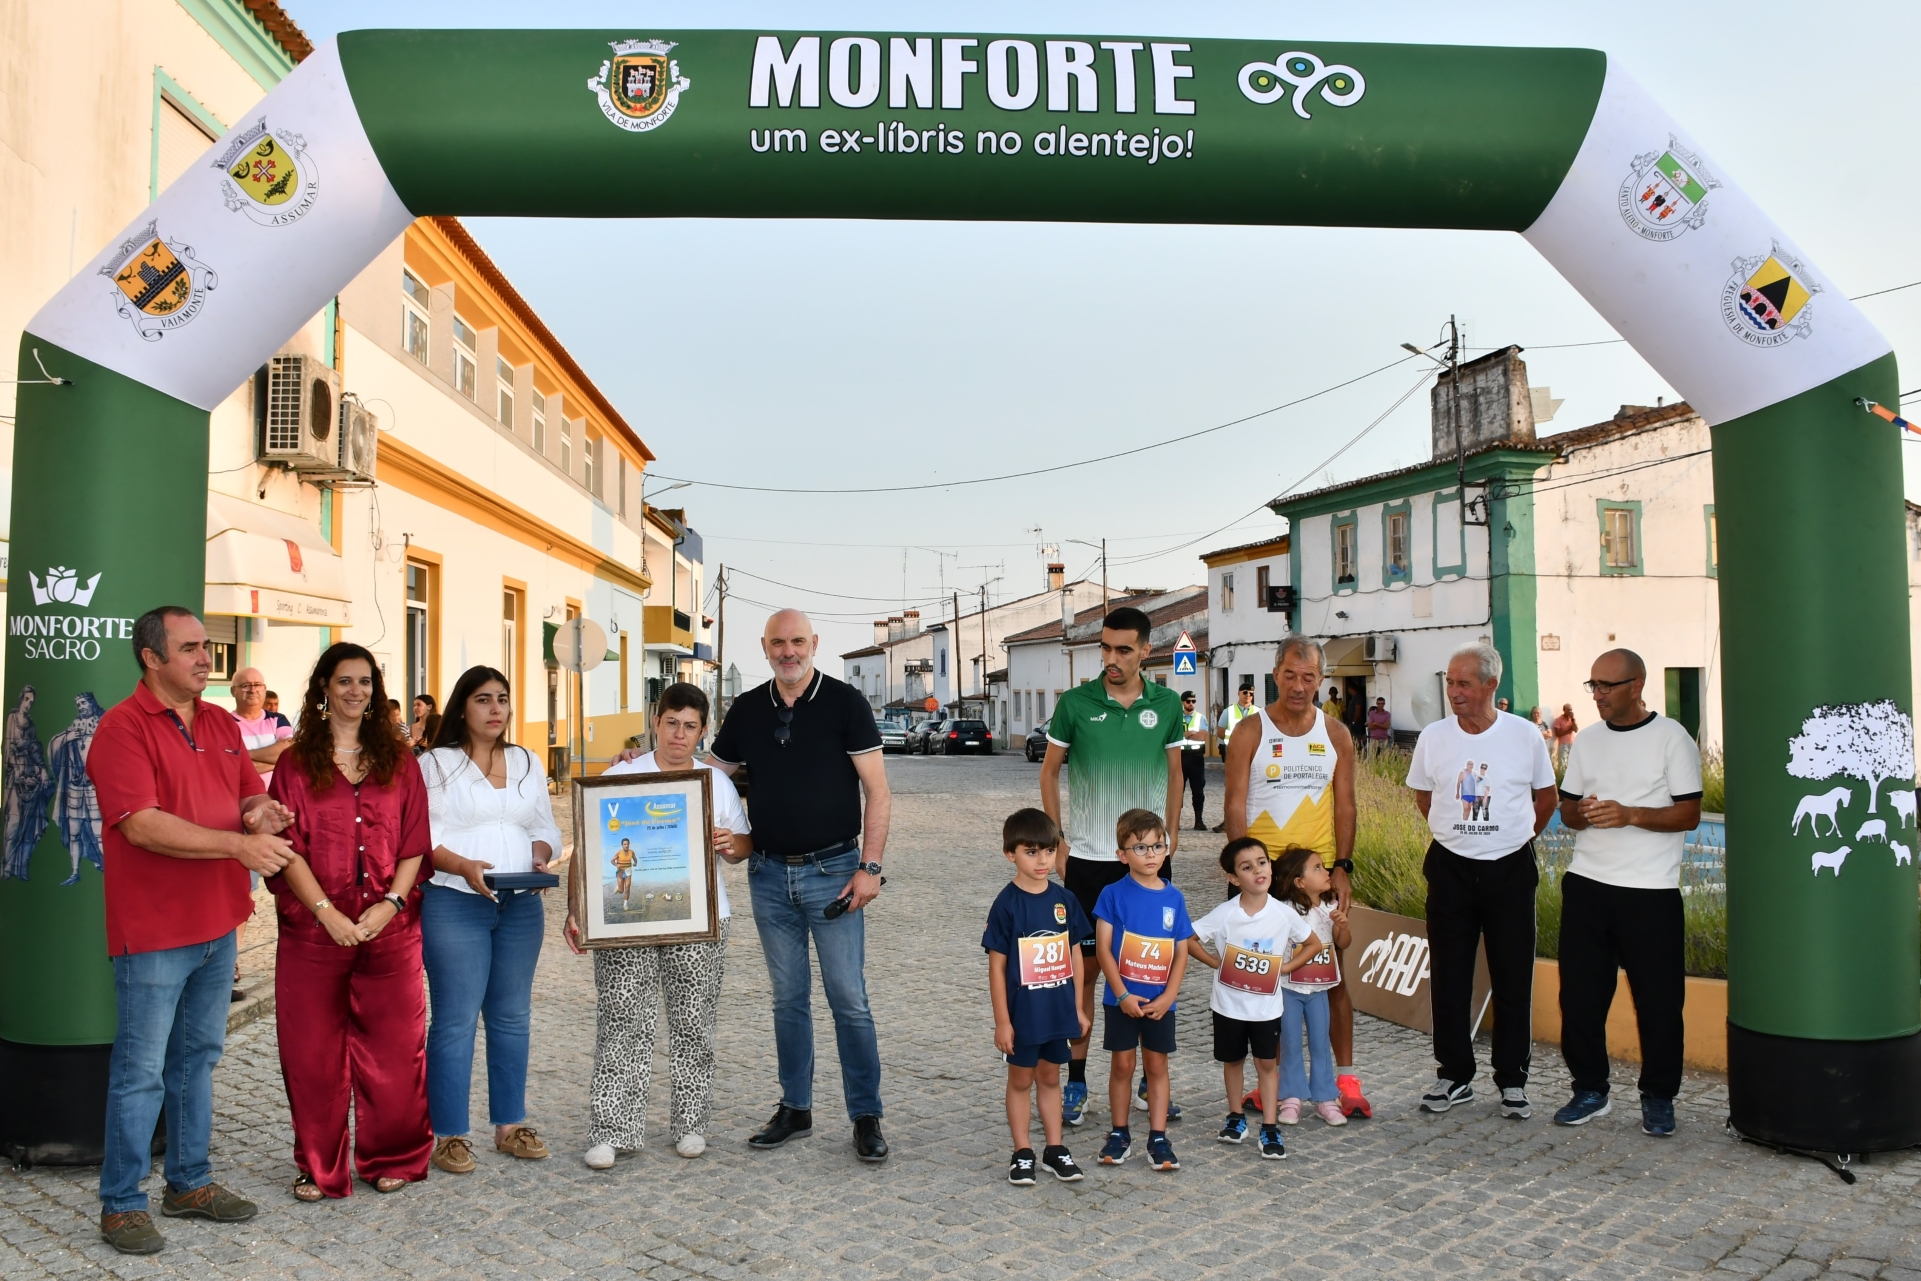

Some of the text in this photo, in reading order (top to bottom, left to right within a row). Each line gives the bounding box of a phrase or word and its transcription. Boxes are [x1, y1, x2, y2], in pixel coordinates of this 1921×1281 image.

[748, 36, 1196, 116] MONFORTE
[602, 101, 676, 130] VILA DE MONFORTE
[750, 120, 1194, 165] um ex-líbris no alentejo!
[271, 182, 317, 225] ASSUMAR
[1620, 185, 1675, 240] SANTO ALEIXO MONFORTE
[161, 288, 204, 328] VAIAMONTE
[1723, 280, 1789, 346] FREGUESIA DE MONFORTE
[10, 615, 135, 639] MONFORTE
[25, 638, 101, 661] SACRO
[1283, 764, 1323, 772] POLITÉCNICO
[1293, 772, 1329, 781] PORTALEGRE
[653, 802, 676, 810] Assumar
[1452, 823, 1466, 831] JOSÉ
[1032, 939, 1065, 965] 287
[1140, 941, 1160, 960] 74
[1033, 965, 1051, 974] Miguel
[1125, 958, 1147, 970] Mateus
[1234, 952, 1271, 975] 539
